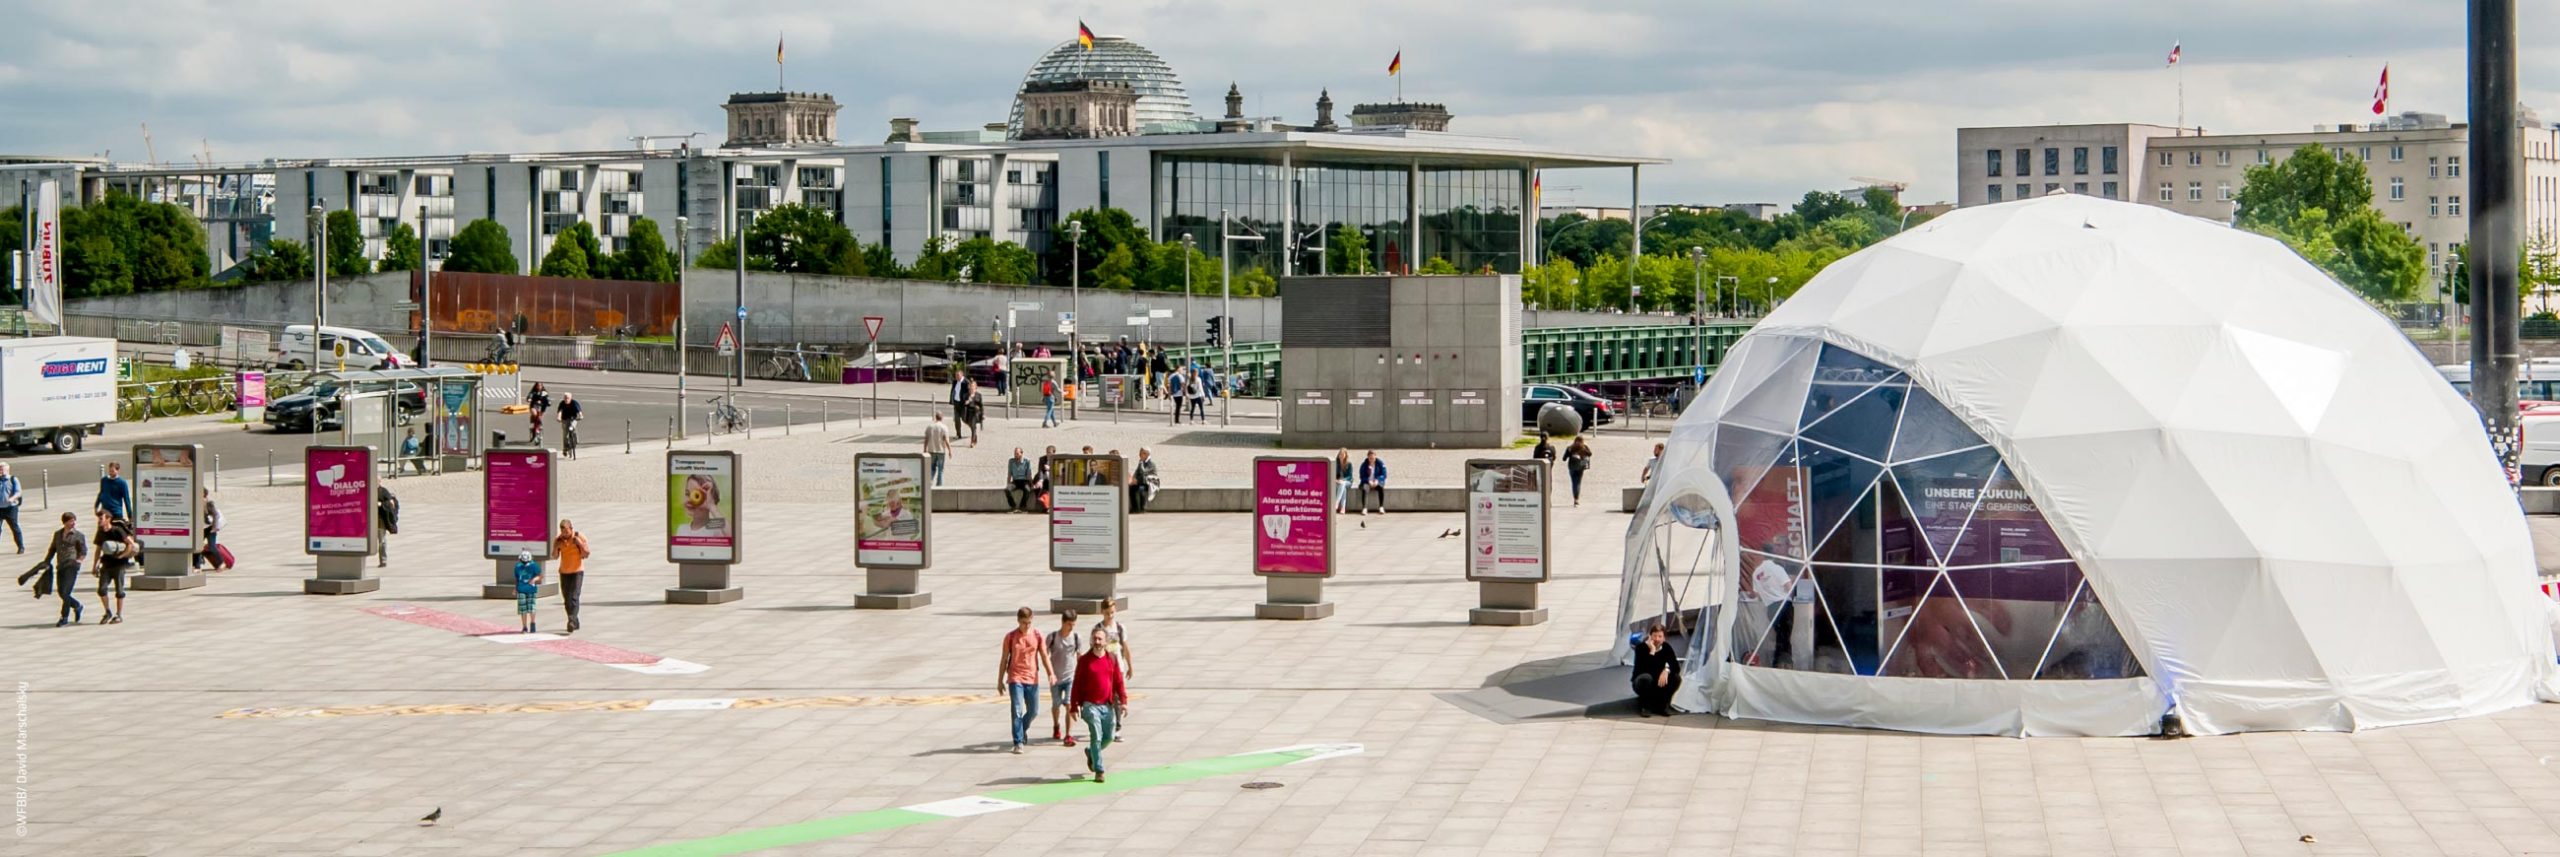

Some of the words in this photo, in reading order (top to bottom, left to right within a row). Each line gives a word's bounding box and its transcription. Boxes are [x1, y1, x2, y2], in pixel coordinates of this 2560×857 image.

[333, 480, 366, 490] DIALOG
[1925, 487, 1975, 499] UNSERE
[1262, 497, 1323, 506] Alexanderplatz,
[1925, 501, 1946, 510] EINE
[1281, 505, 1323, 513] Funktürme
[1787, 477, 1802, 559] SCHAFT
